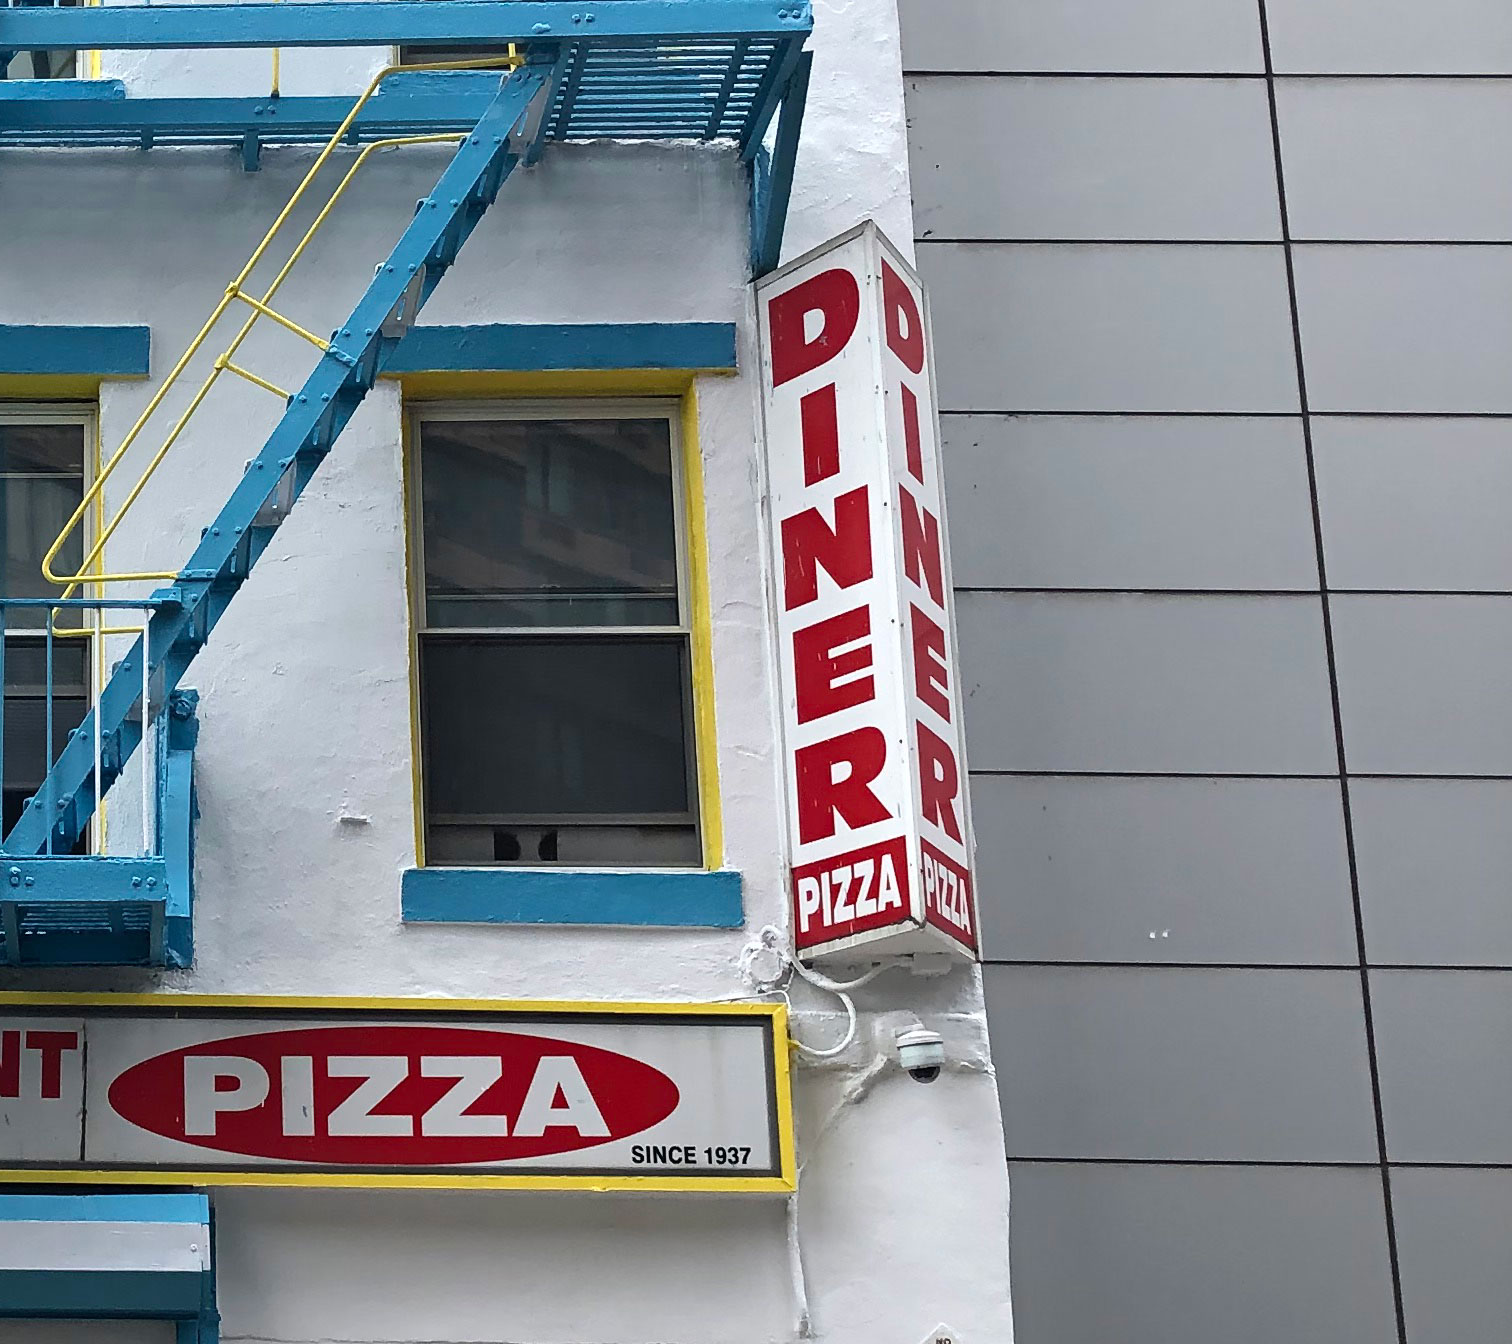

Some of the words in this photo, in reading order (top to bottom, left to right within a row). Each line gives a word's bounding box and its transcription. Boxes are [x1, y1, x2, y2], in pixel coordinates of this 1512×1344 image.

[769, 267, 895, 848] DINER
[880, 257, 962, 846] DINER
[798, 853, 902, 934] PIZZA
[923, 851, 972, 936] PIZZA
[183, 1055, 612, 1137] PIZZA
[631, 1145, 697, 1165] SINCE
[703, 1146, 752, 1166] 1937
